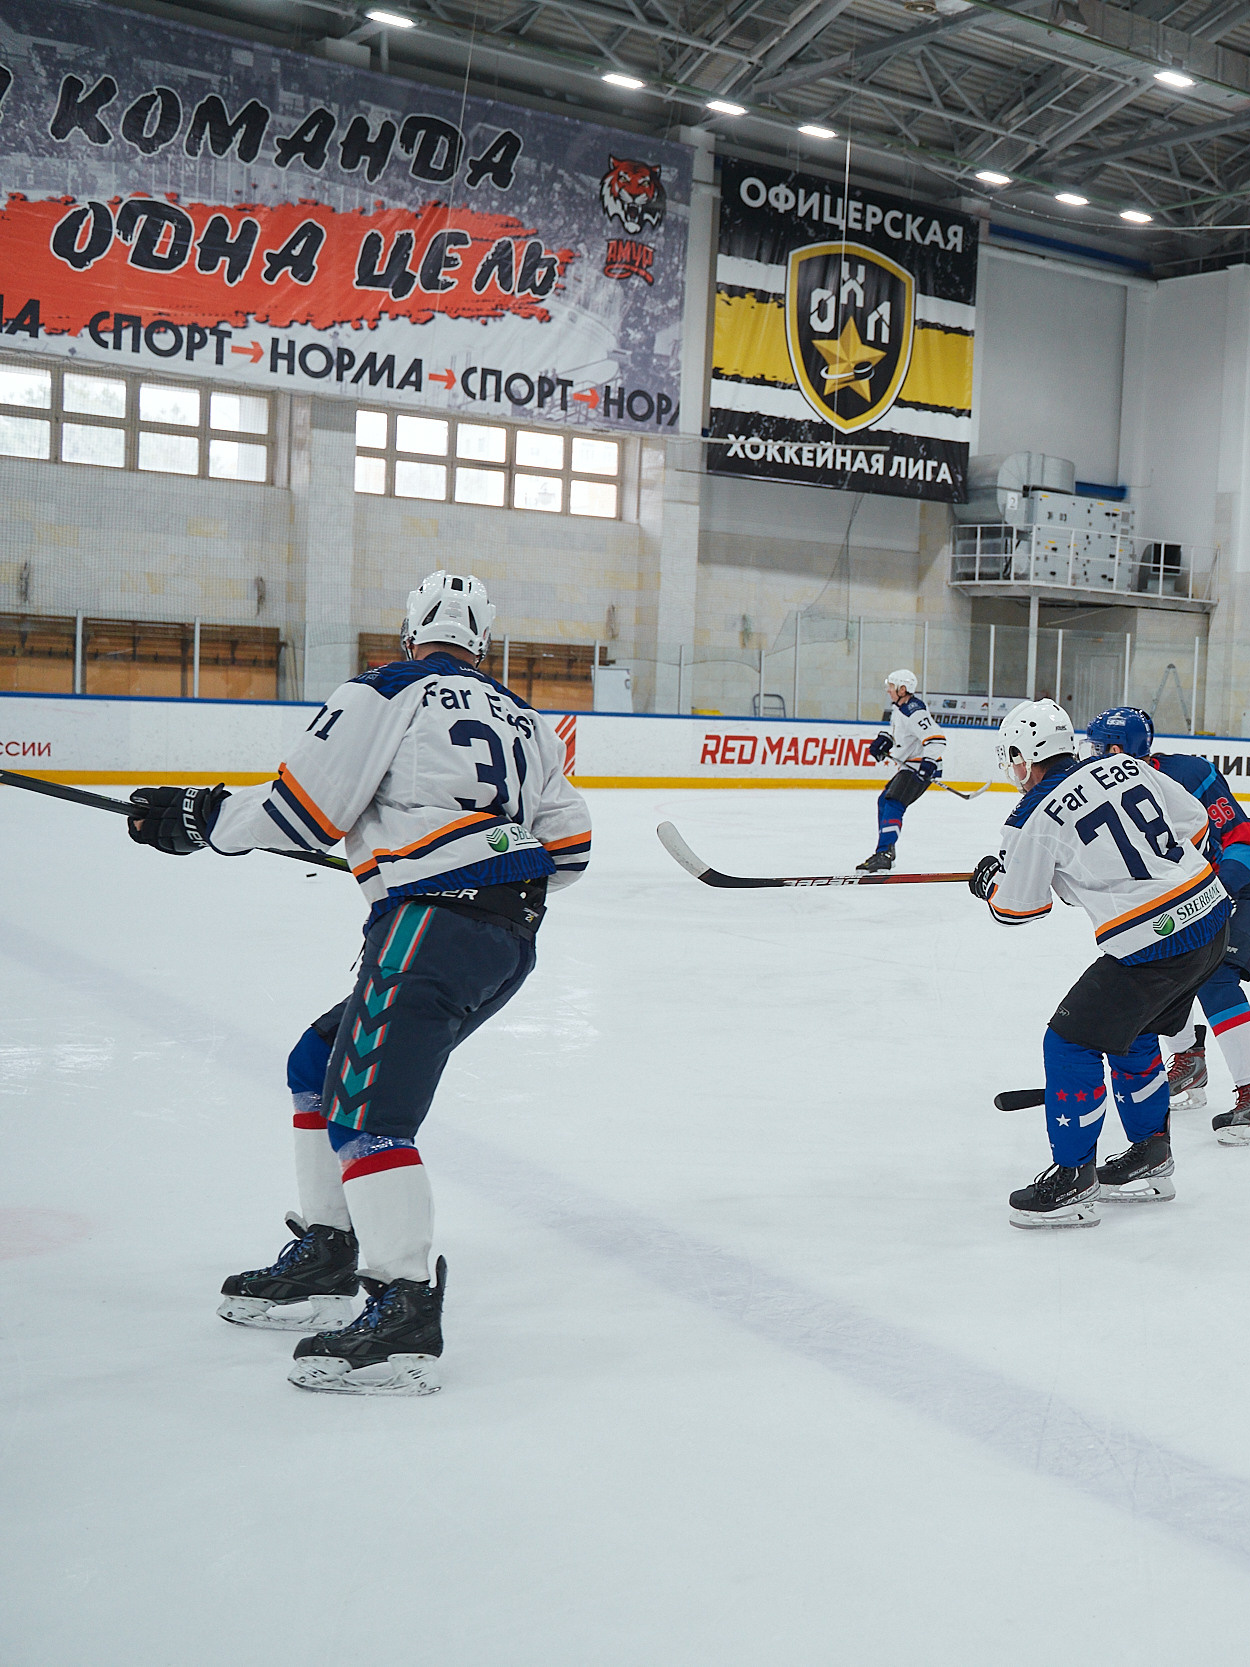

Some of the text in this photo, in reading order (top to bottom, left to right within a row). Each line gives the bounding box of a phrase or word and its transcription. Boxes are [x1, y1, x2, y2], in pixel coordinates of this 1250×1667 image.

[49, 73, 523, 192] КОМАНДА
[739, 177, 965, 253] ОФИЦЕРСКАЯ
[50, 198, 560, 301] ОДНА ЦЕЛЬ
[605, 239, 655, 278] АМУР
[88, 311, 233, 366] СПОРТ
[270, 336, 424, 393] НОРМА
[460, 366, 574, 413] СПОРТ
[726, 433, 953, 485] ХОККЕЙНАЯ ЛИГА
[421, 680, 472, 710] Far
[918, 717, 932, 730] 57
[700, 734, 877, 767] RED MACHINE
[1044, 759, 1140, 827] Far Eas
[1207, 797, 1235, 828] 96
[1075, 783, 1185, 881] 78
